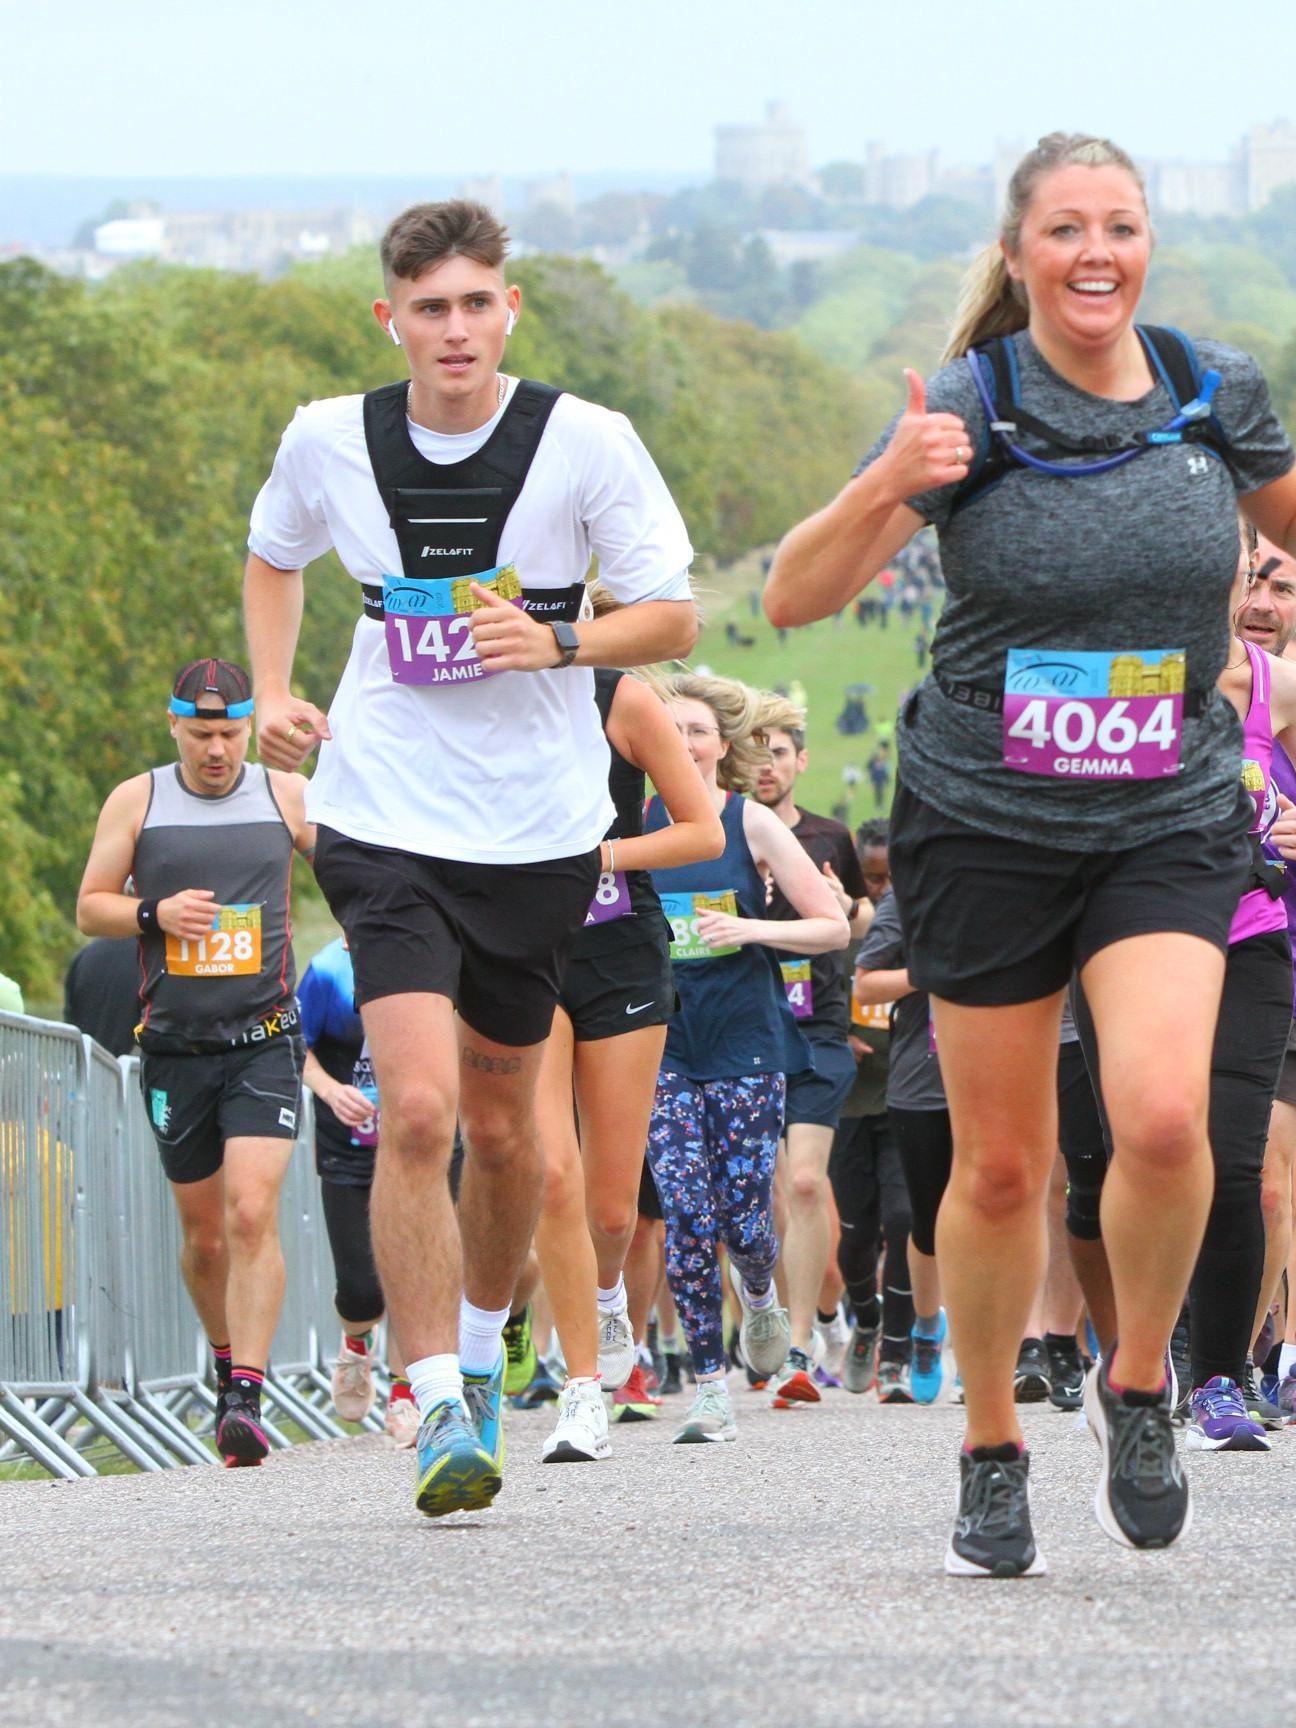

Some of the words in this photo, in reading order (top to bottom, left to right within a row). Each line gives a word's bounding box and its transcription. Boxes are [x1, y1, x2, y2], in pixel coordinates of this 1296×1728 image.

[429, 548, 474, 556] ZELAFIT
[432, 663, 483, 682] JAMIE
[1008, 700, 1177, 754] 4064
[1054, 757, 1134, 775] GEMMA
[181, 930, 253, 962] 1128
[195, 964, 235, 975] GABOR
